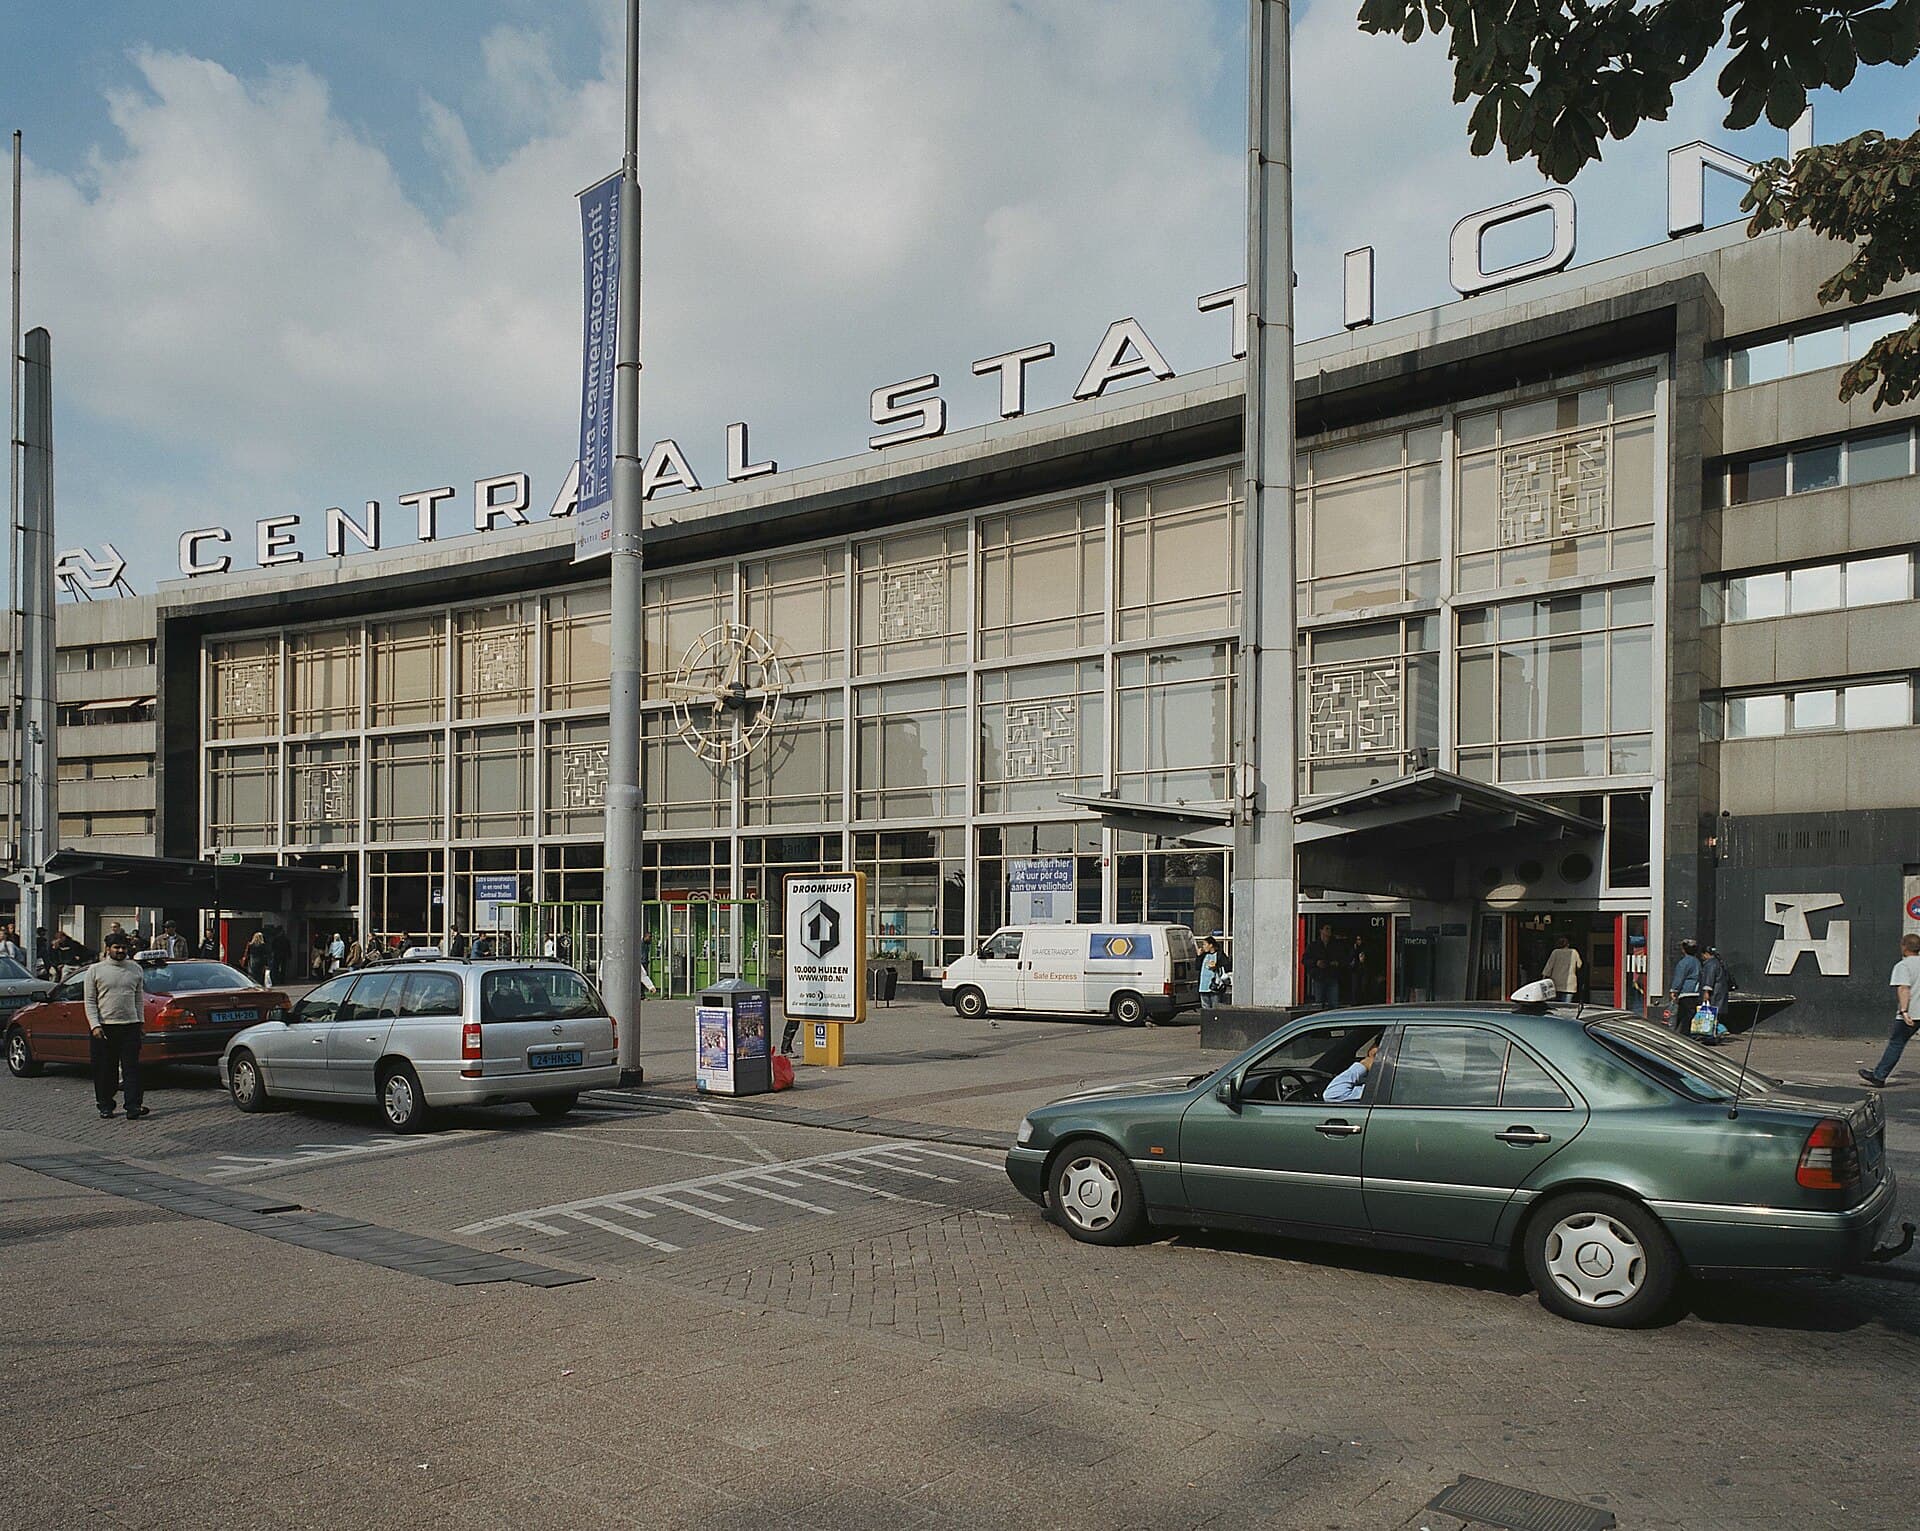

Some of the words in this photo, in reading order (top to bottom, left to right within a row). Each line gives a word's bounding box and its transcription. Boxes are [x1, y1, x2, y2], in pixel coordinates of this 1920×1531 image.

[606, 194, 619, 267] Station
[869, 104, 1814, 450] STATION
[587, 203, 604, 420] cameratoezicht
[601, 406, 610, 437] om
[581, 428, 596, 501] Extra
[600, 445, 609, 469] en
[598, 476, 608, 495] in
[1014, 860, 1026, 870] Wij
[1028, 860, 1053, 868] werken
[1055, 858, 1070, 868] hier
[1016, 871, 1025, 880] 24
[1026, 872, 1039, 880] uur
[1040, 872, 1052, 881] per
[1053, 870, 1067, 881] dag
[793, 883, 851, 894] DROOMHUIS?
[1038, 881, 1072, 891] veiligheid
[1404, 936, 1428, 945] metro
[794, 966, 816, 974] 10.000
[818, 966, 848, 974] HUIZEN
[1033, 972, 1048, 980] Safe
[1050, 972, 1077, 982] Express
